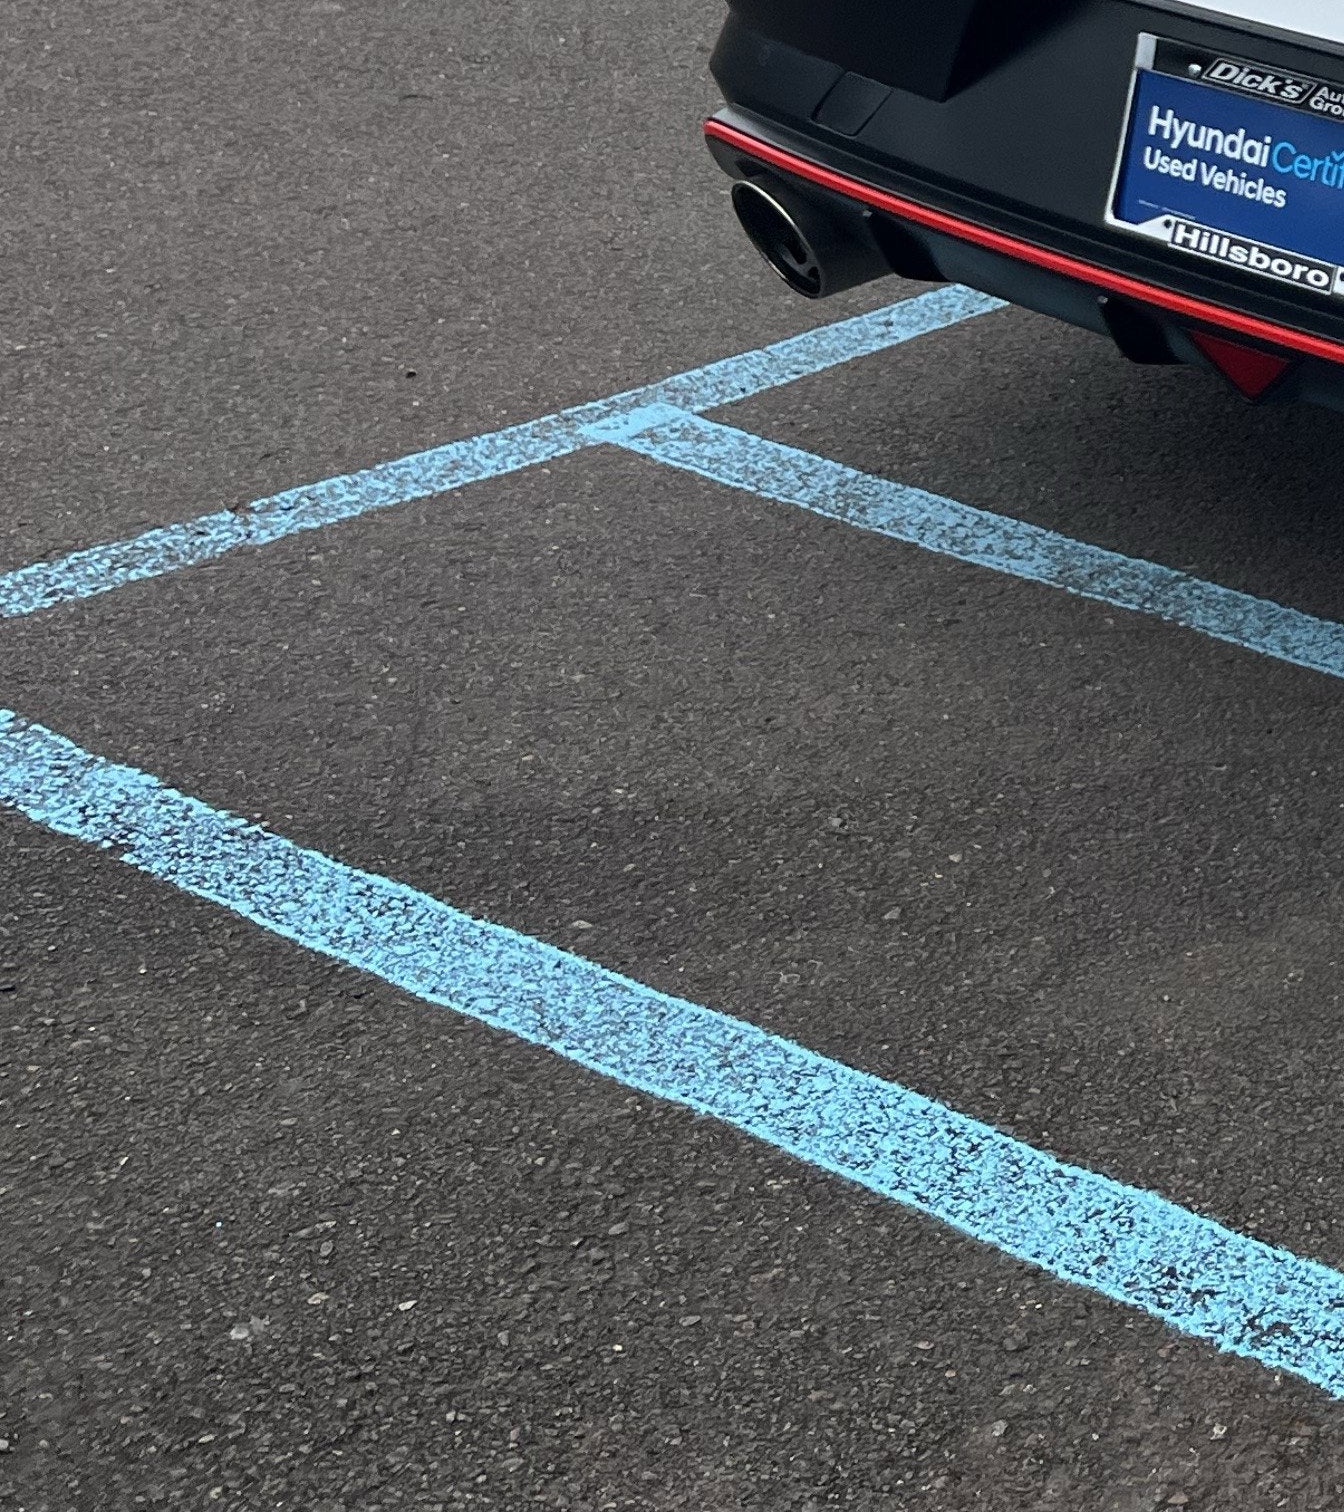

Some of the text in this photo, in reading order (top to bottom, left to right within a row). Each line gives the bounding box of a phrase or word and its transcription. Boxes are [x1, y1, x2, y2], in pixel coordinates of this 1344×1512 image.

[1209, 62, 1303, 100] Dick's
[1148, 105, 1272, 168] Hyundai
[1143, 145, 1287, 208] Used Vehicles
[1173, 222, 1330, 288] Hillsboro
